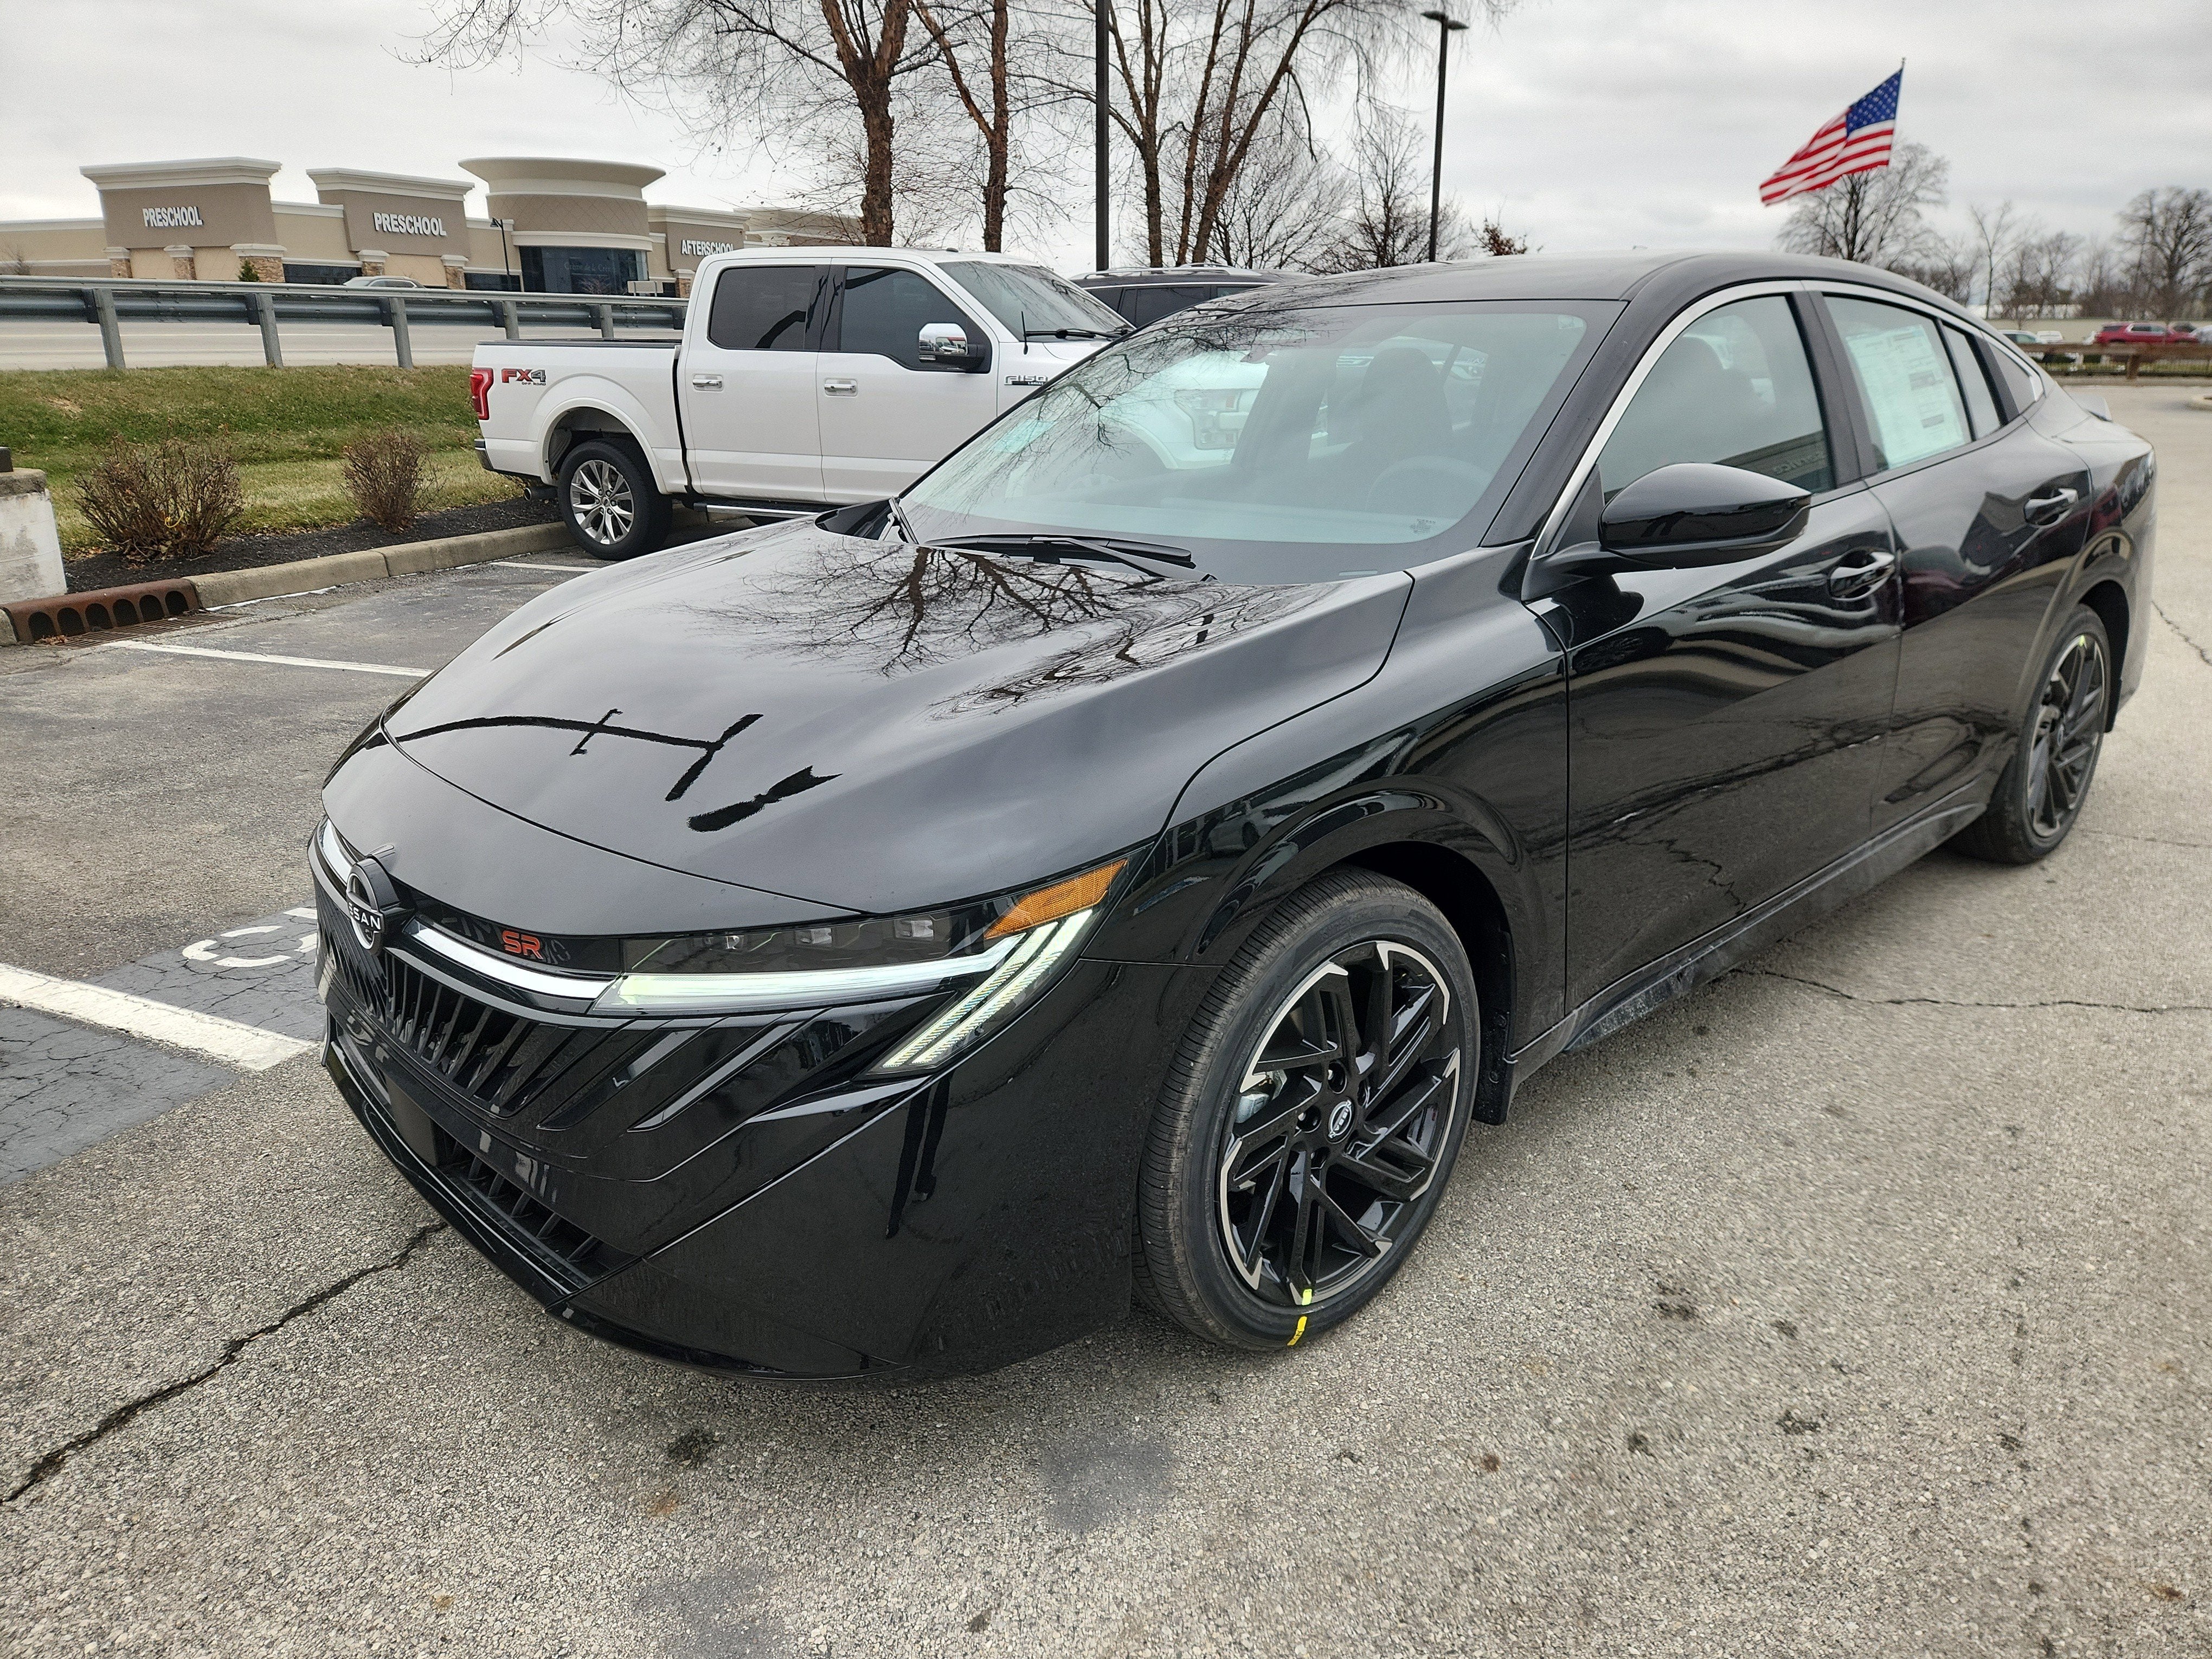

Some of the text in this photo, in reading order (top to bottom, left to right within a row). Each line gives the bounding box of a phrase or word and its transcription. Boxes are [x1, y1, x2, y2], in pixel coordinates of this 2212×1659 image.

[142, 207, 204, 227] PRESCHOOL
[373, 212, 447, 236] PRESCHOOL
[501, 369, 546, 383] FX4
[502, 930, 543, 960] SR
